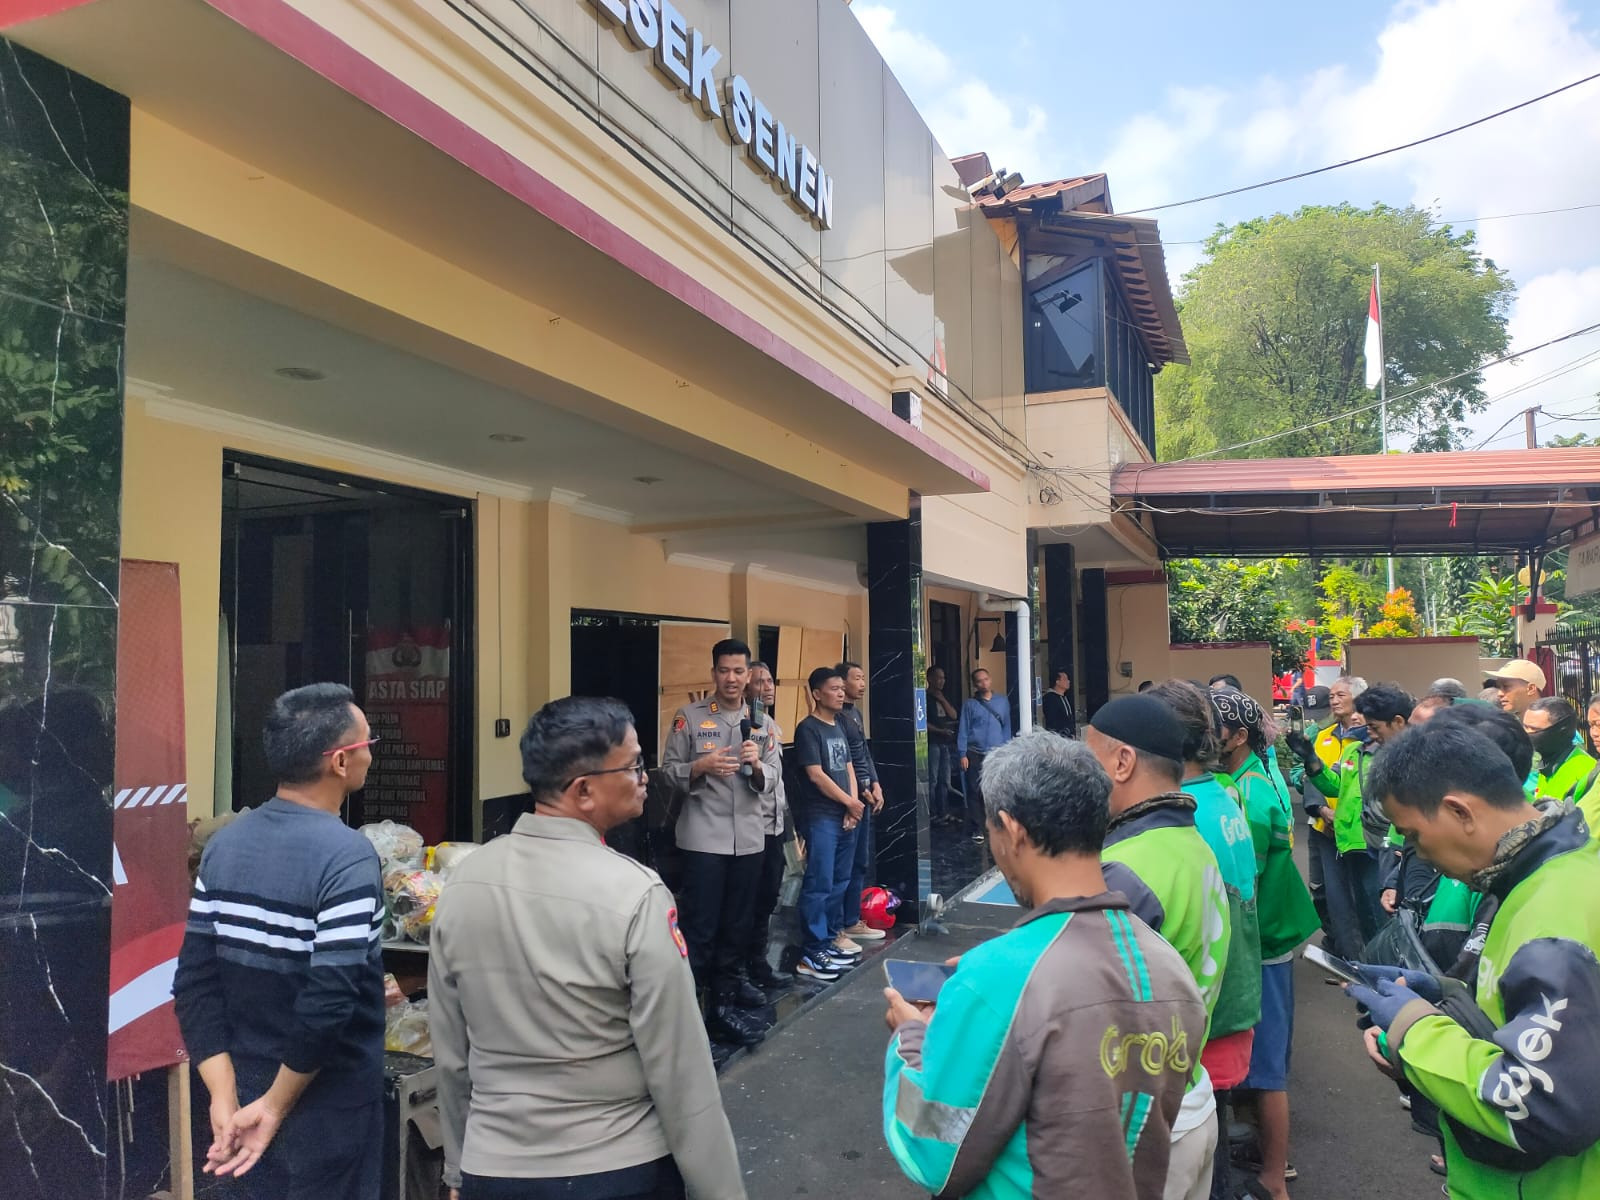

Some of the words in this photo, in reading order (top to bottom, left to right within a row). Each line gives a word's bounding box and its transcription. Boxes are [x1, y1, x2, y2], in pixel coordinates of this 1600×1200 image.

[599, 0, 722, 118] SEK
[725, 74, 833, 230] SENEN
[369, 680, 406, 699] ASTA
[697, 730, 721, 739] ANDRE
[1100, 1015, 1190, 1079] Grab
[1493, 992, 1568, 1121] gojek
